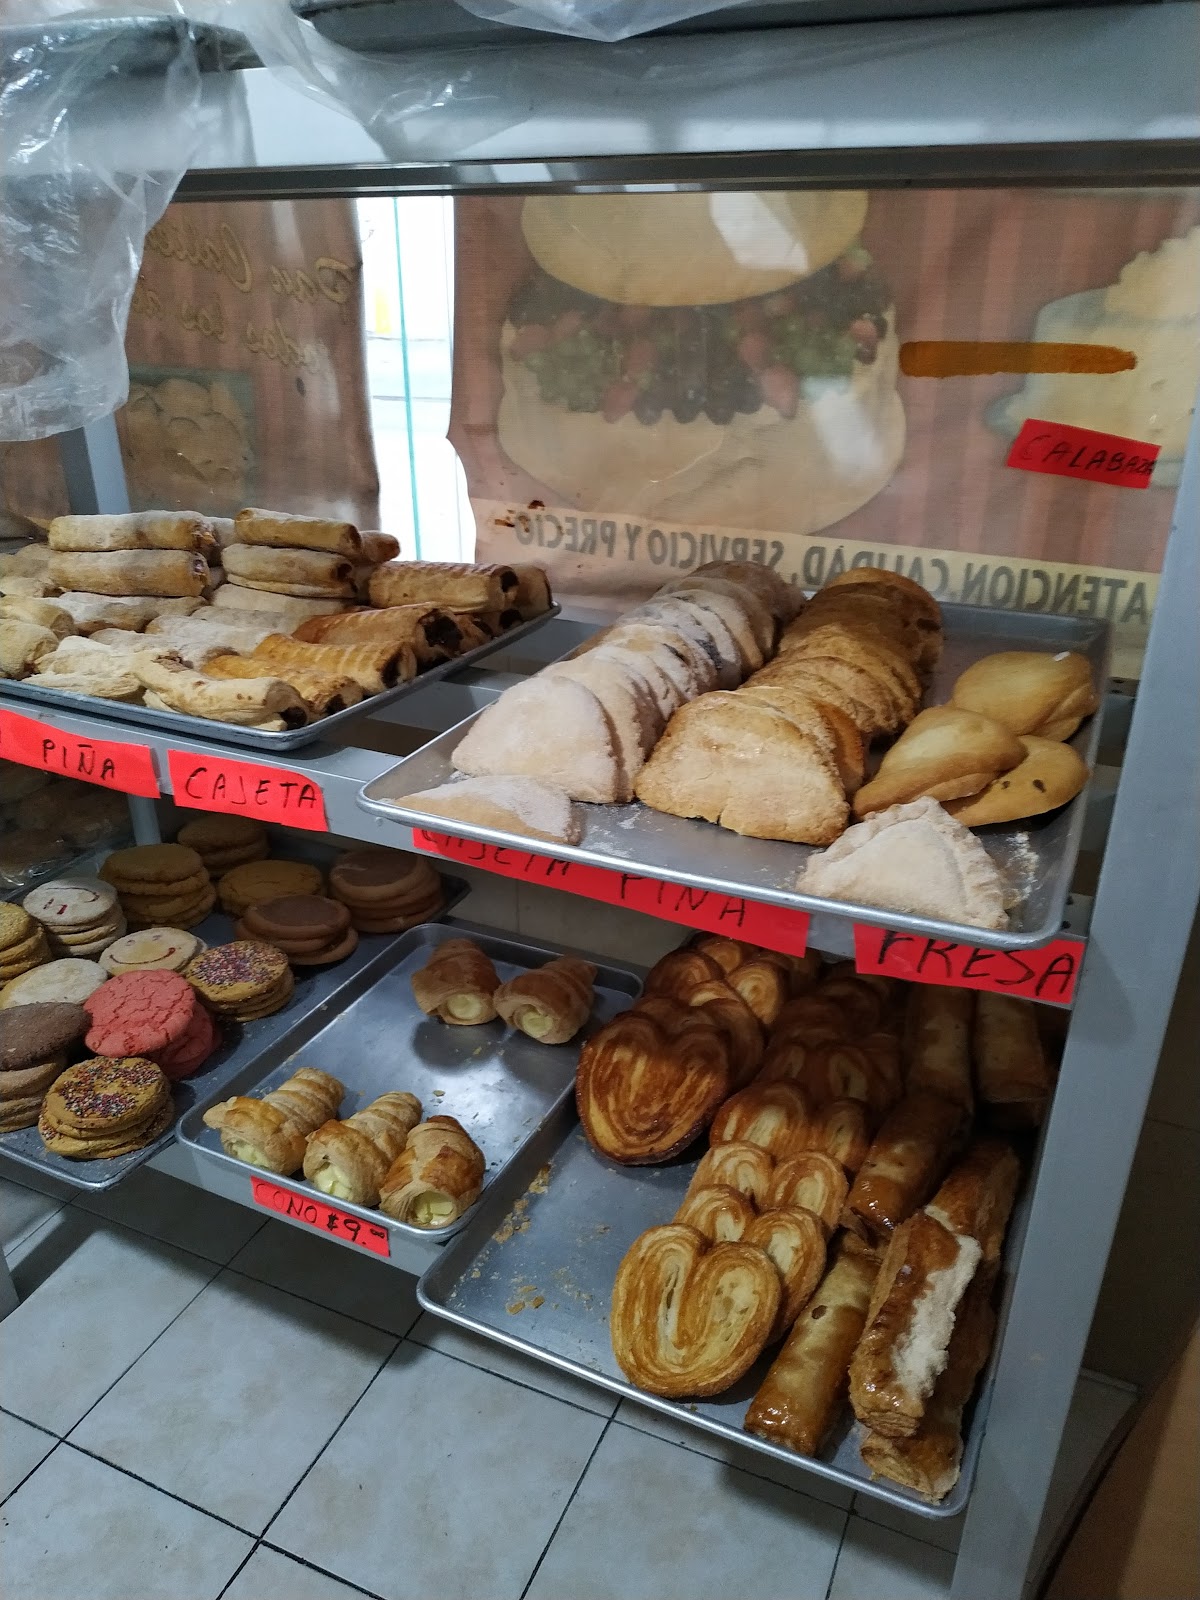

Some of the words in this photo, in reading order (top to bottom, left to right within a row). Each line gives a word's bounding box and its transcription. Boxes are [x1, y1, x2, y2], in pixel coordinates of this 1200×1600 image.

[42, 738, 116, 780] PIÑA
[184, 767, 318, 808] CAJETA
[877, 930, 1075, 996] FRESA
[255, 1183, 318, 1224] CONO
